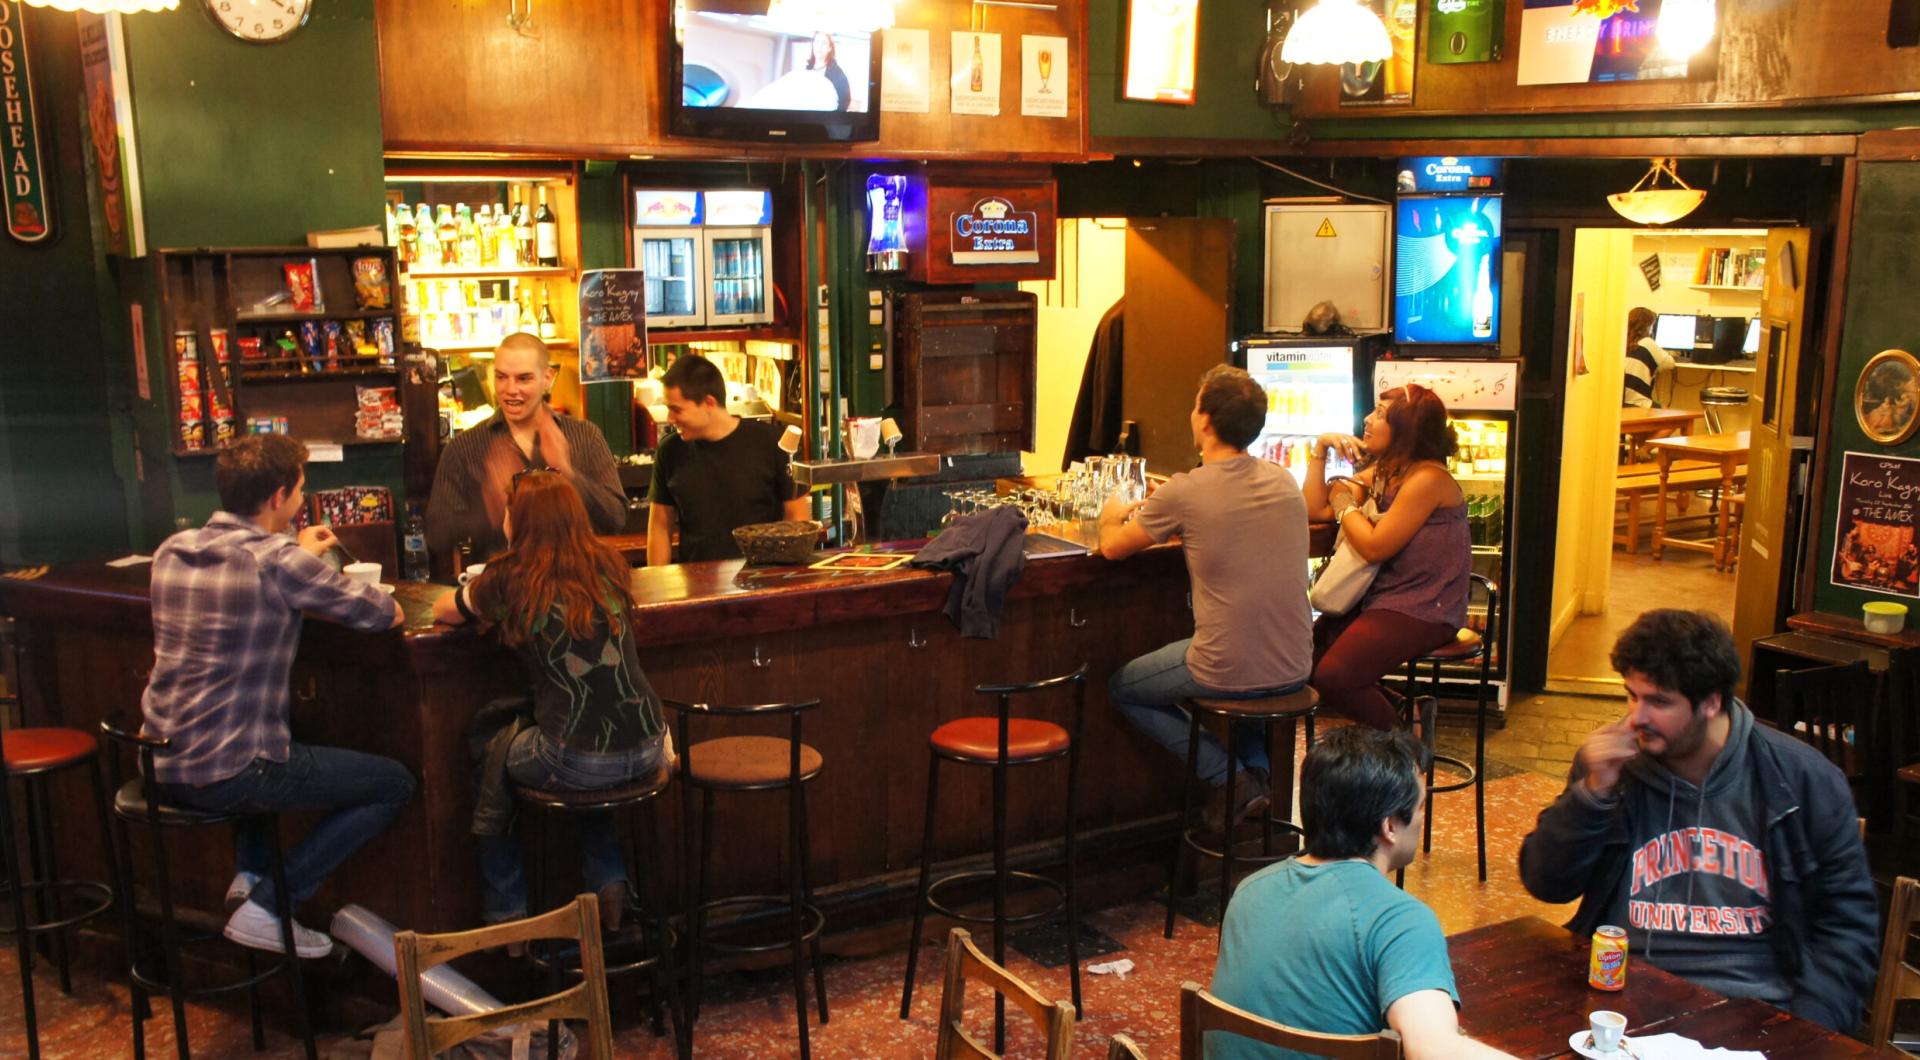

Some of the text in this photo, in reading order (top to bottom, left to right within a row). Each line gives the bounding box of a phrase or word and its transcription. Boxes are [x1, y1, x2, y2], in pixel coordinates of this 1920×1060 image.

[235, 17, 244, 27] 7
[254, 24, 264, 34] 6
[1426, 163, 1472, 176] Corona
[957, 214, 1028, 237] Corona
[973, 236, 1014, 250] Extra
[1863, 507, 1884, 519] THE
